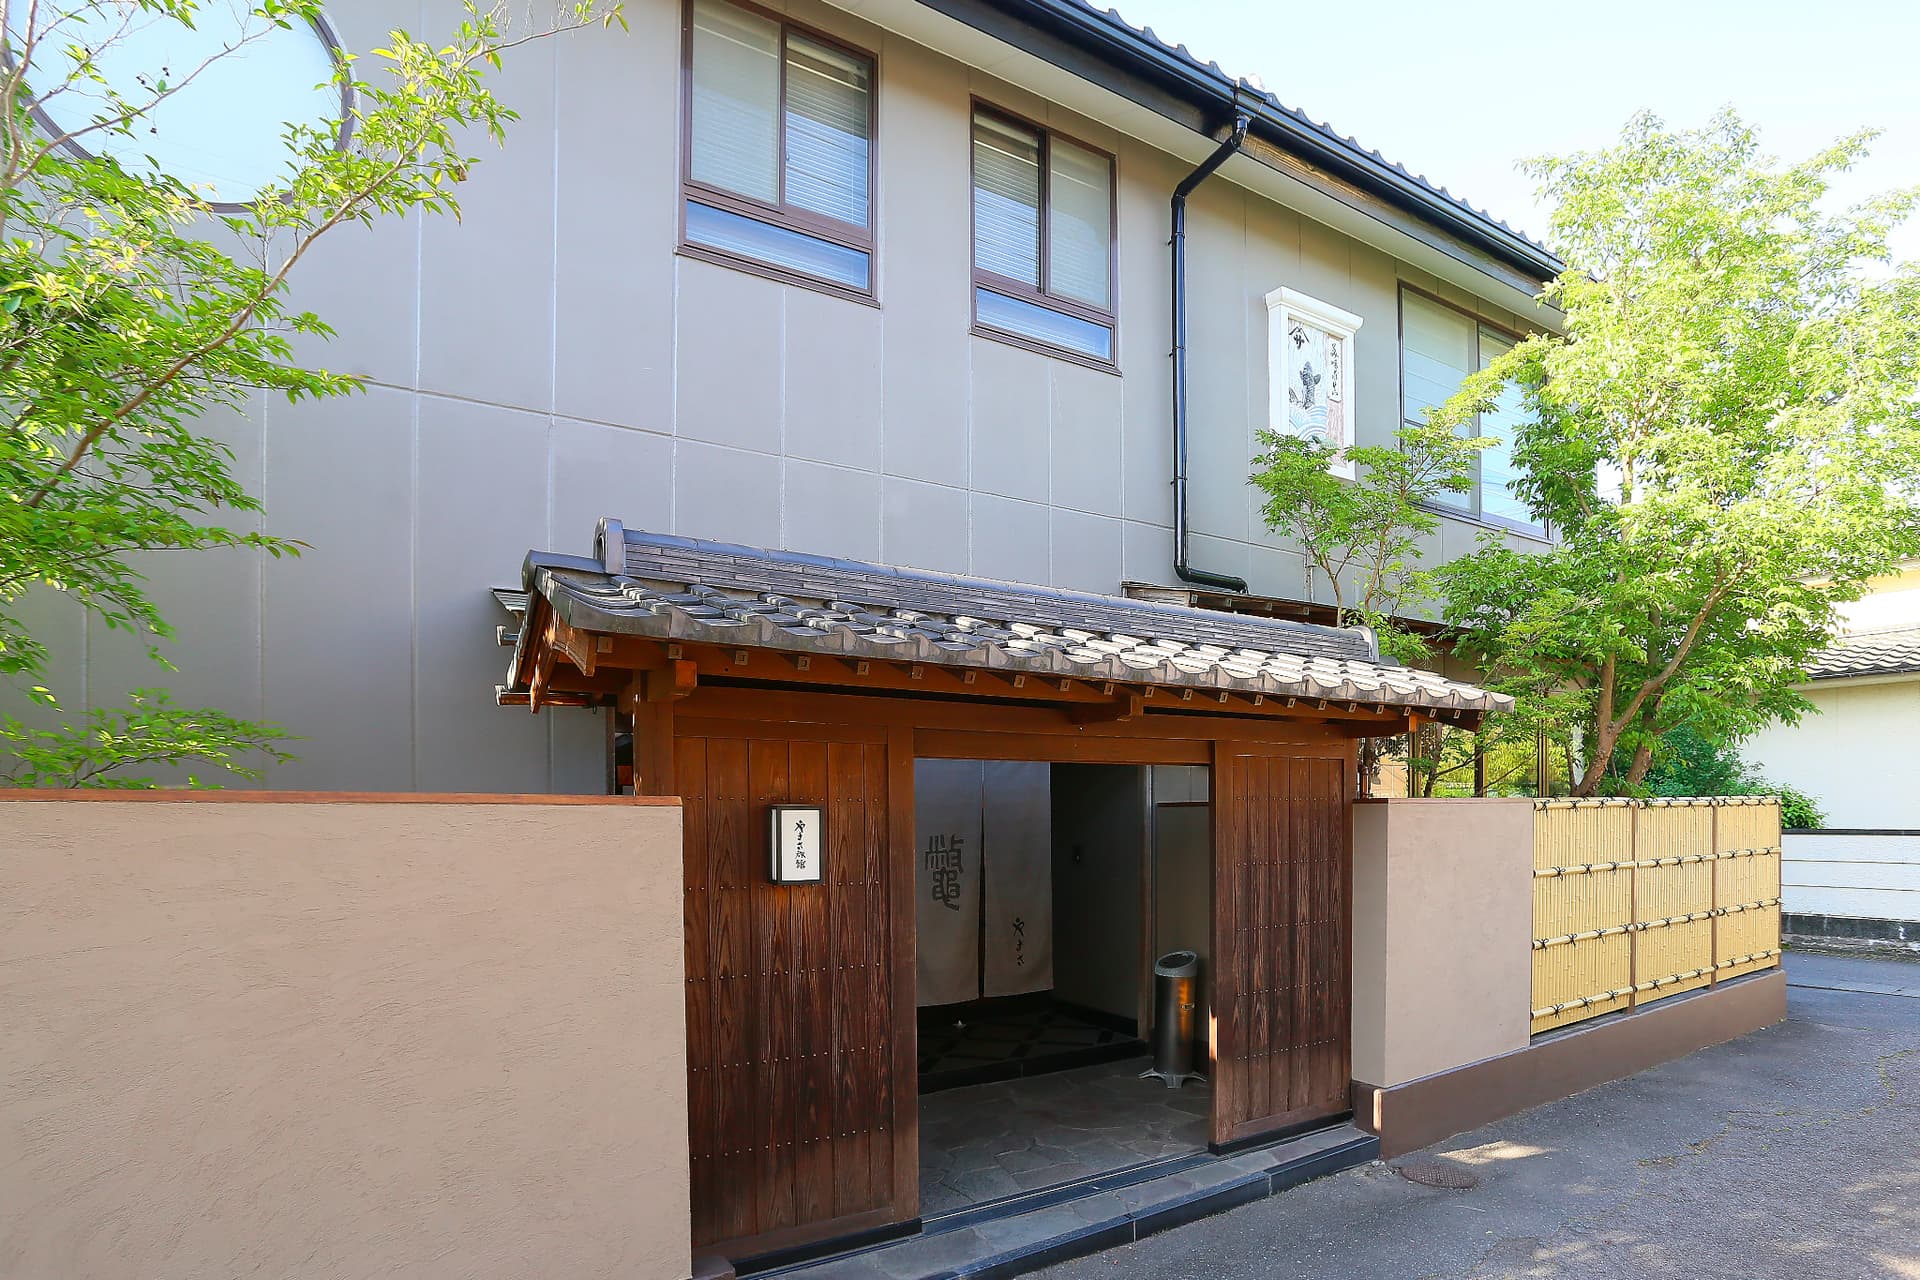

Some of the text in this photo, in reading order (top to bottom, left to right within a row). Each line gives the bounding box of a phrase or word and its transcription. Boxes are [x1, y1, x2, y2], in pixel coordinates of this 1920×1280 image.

[794, 819, 807, 869] やまさ旅館
[1012, 917, 1025, 966] やまさ
